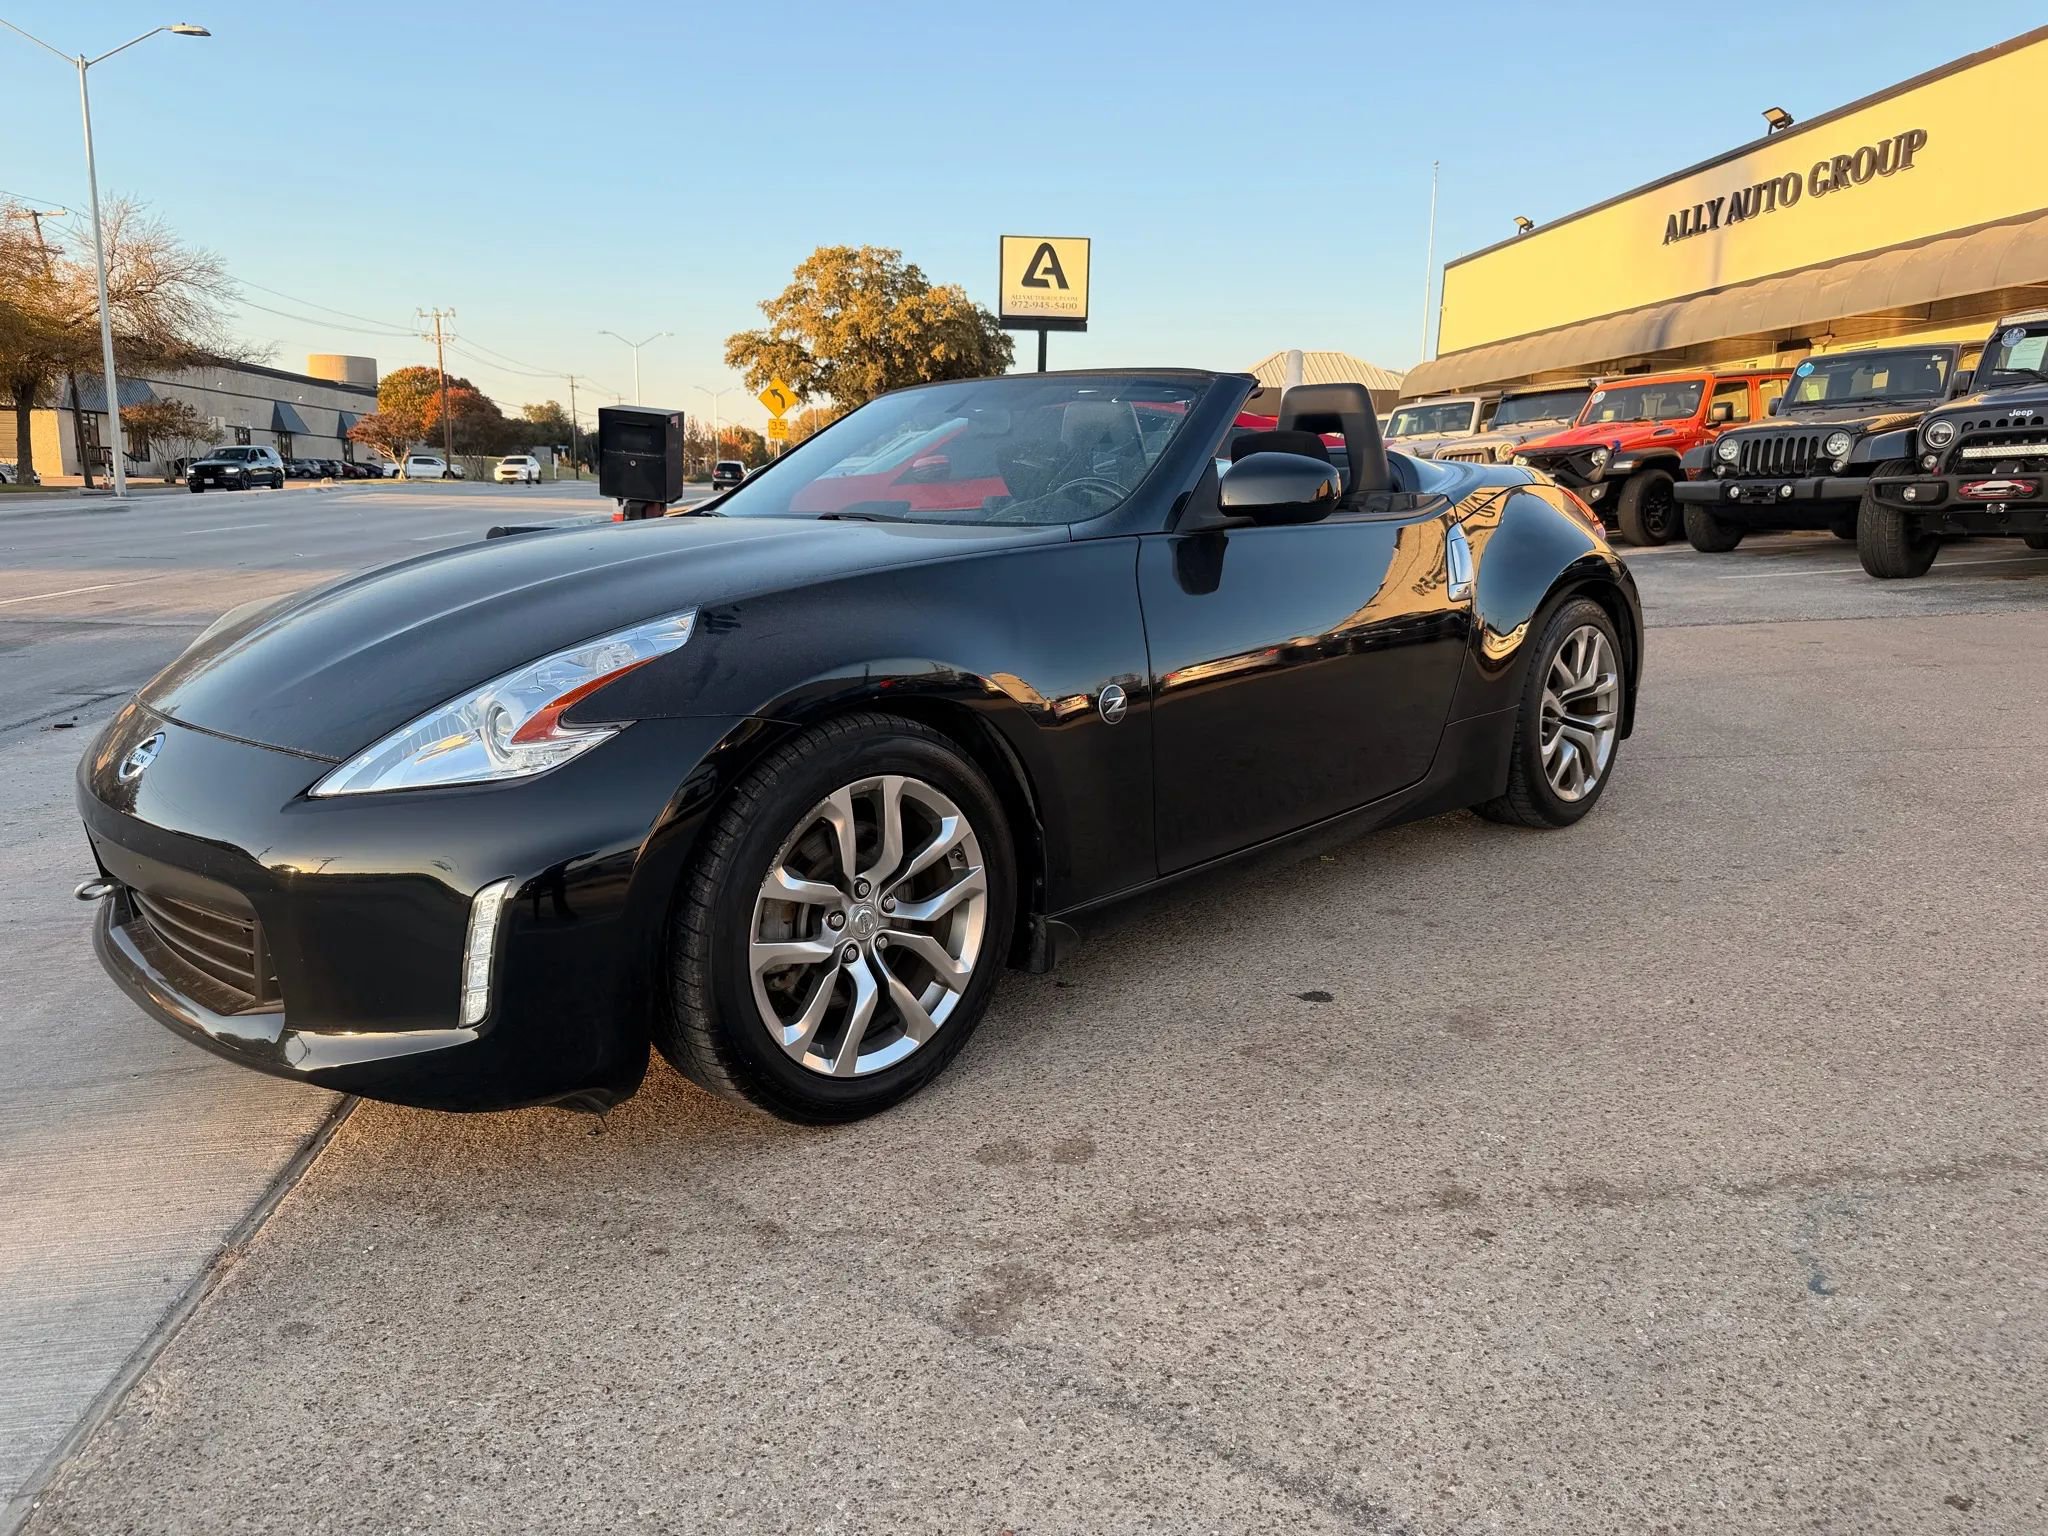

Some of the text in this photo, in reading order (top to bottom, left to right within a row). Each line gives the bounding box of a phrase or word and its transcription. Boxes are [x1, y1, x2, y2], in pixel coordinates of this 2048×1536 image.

[1662, 129, 1928, 246] ALLY AUTO GROUP
[1011, 300, 1078, 311] 972-945-5400
[2008, 409, 2034, 417] Jeep
[771, 421, 786, 431] 35
